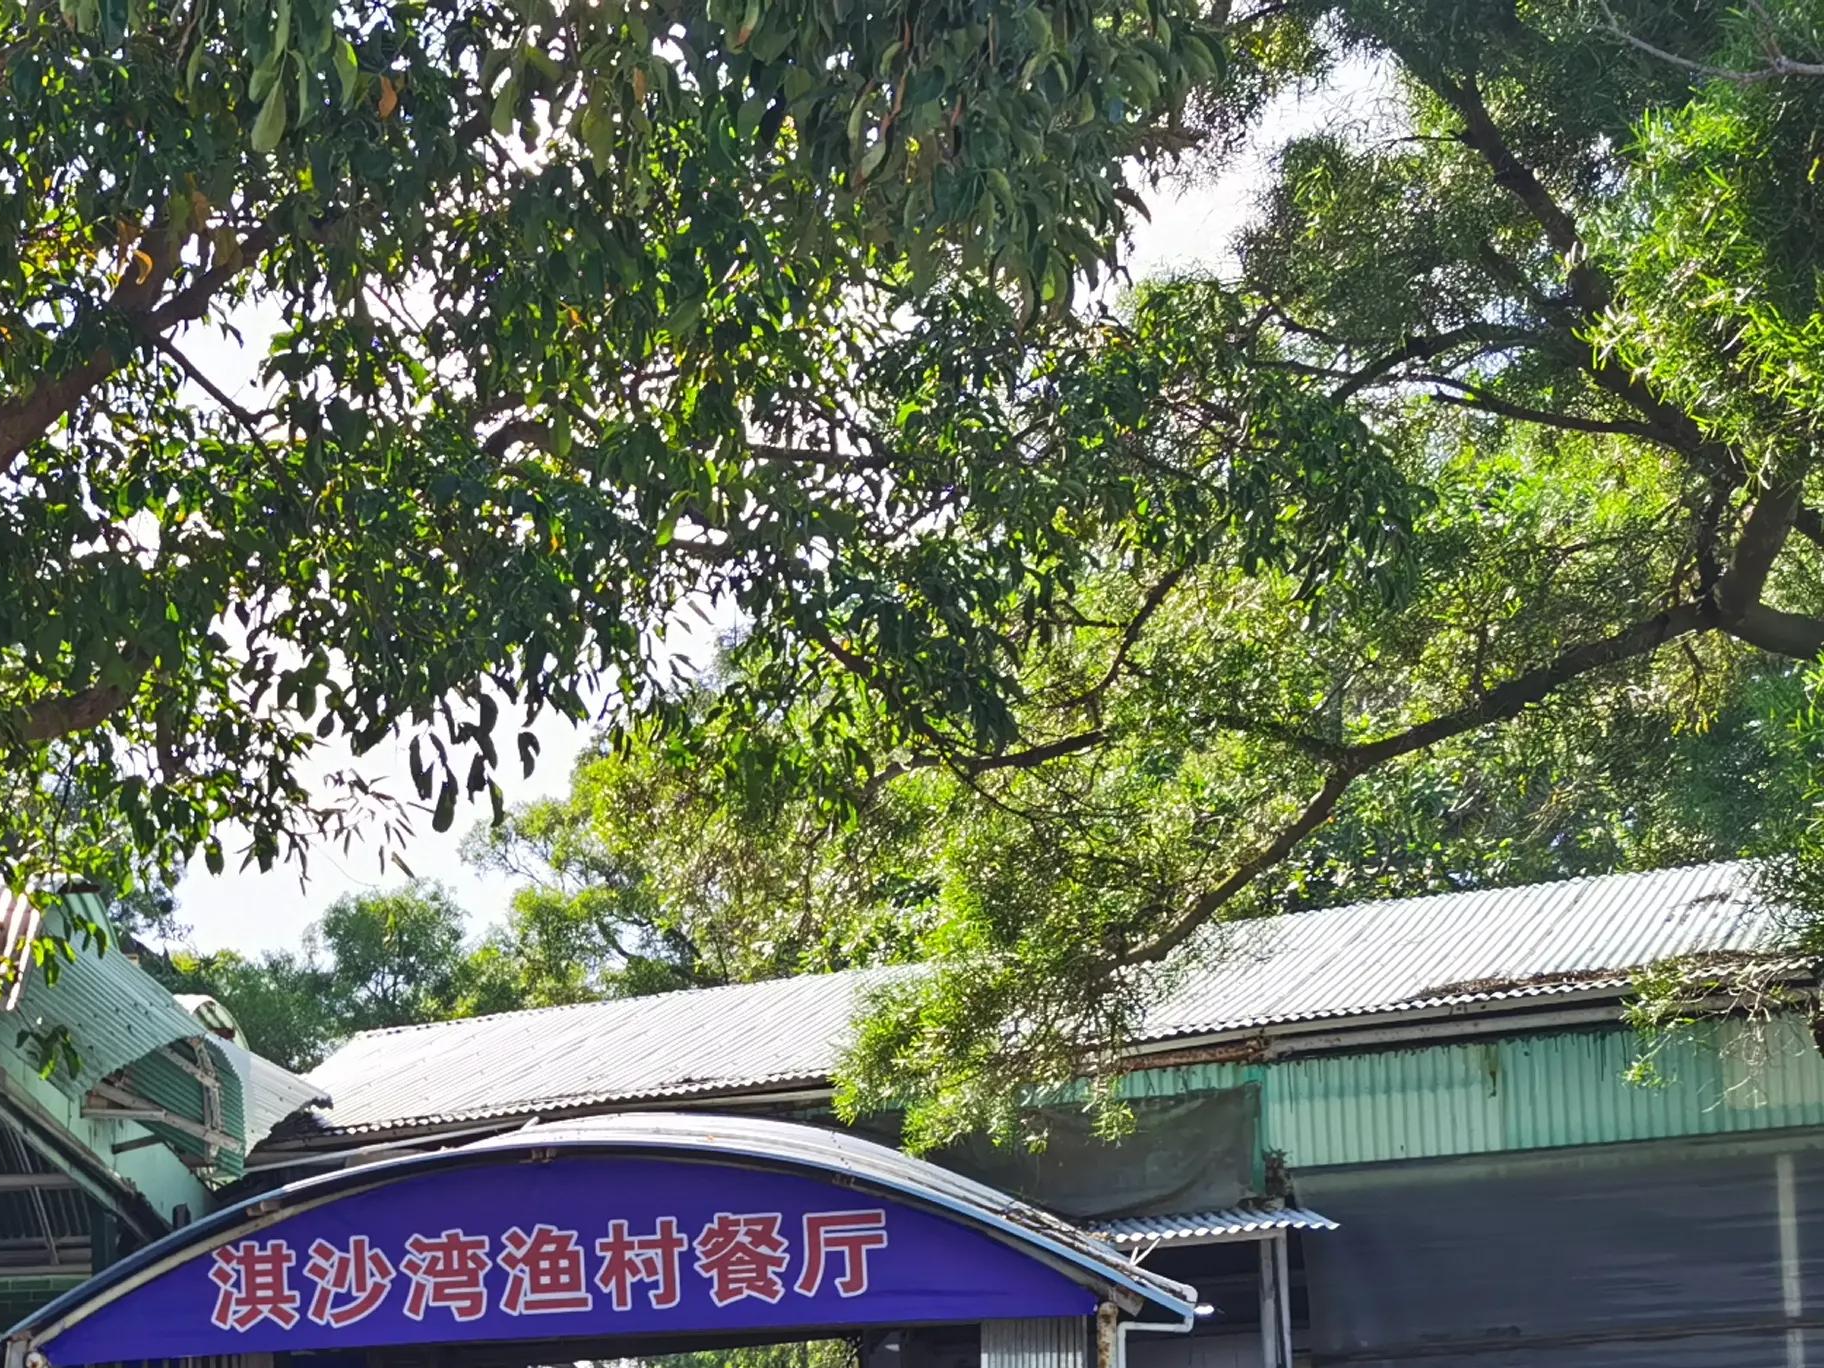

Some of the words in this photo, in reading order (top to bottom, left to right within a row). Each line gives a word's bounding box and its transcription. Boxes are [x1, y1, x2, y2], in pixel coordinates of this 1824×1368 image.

[210, 1209, 887, 1331] 淇沙湾渔村餐厅
